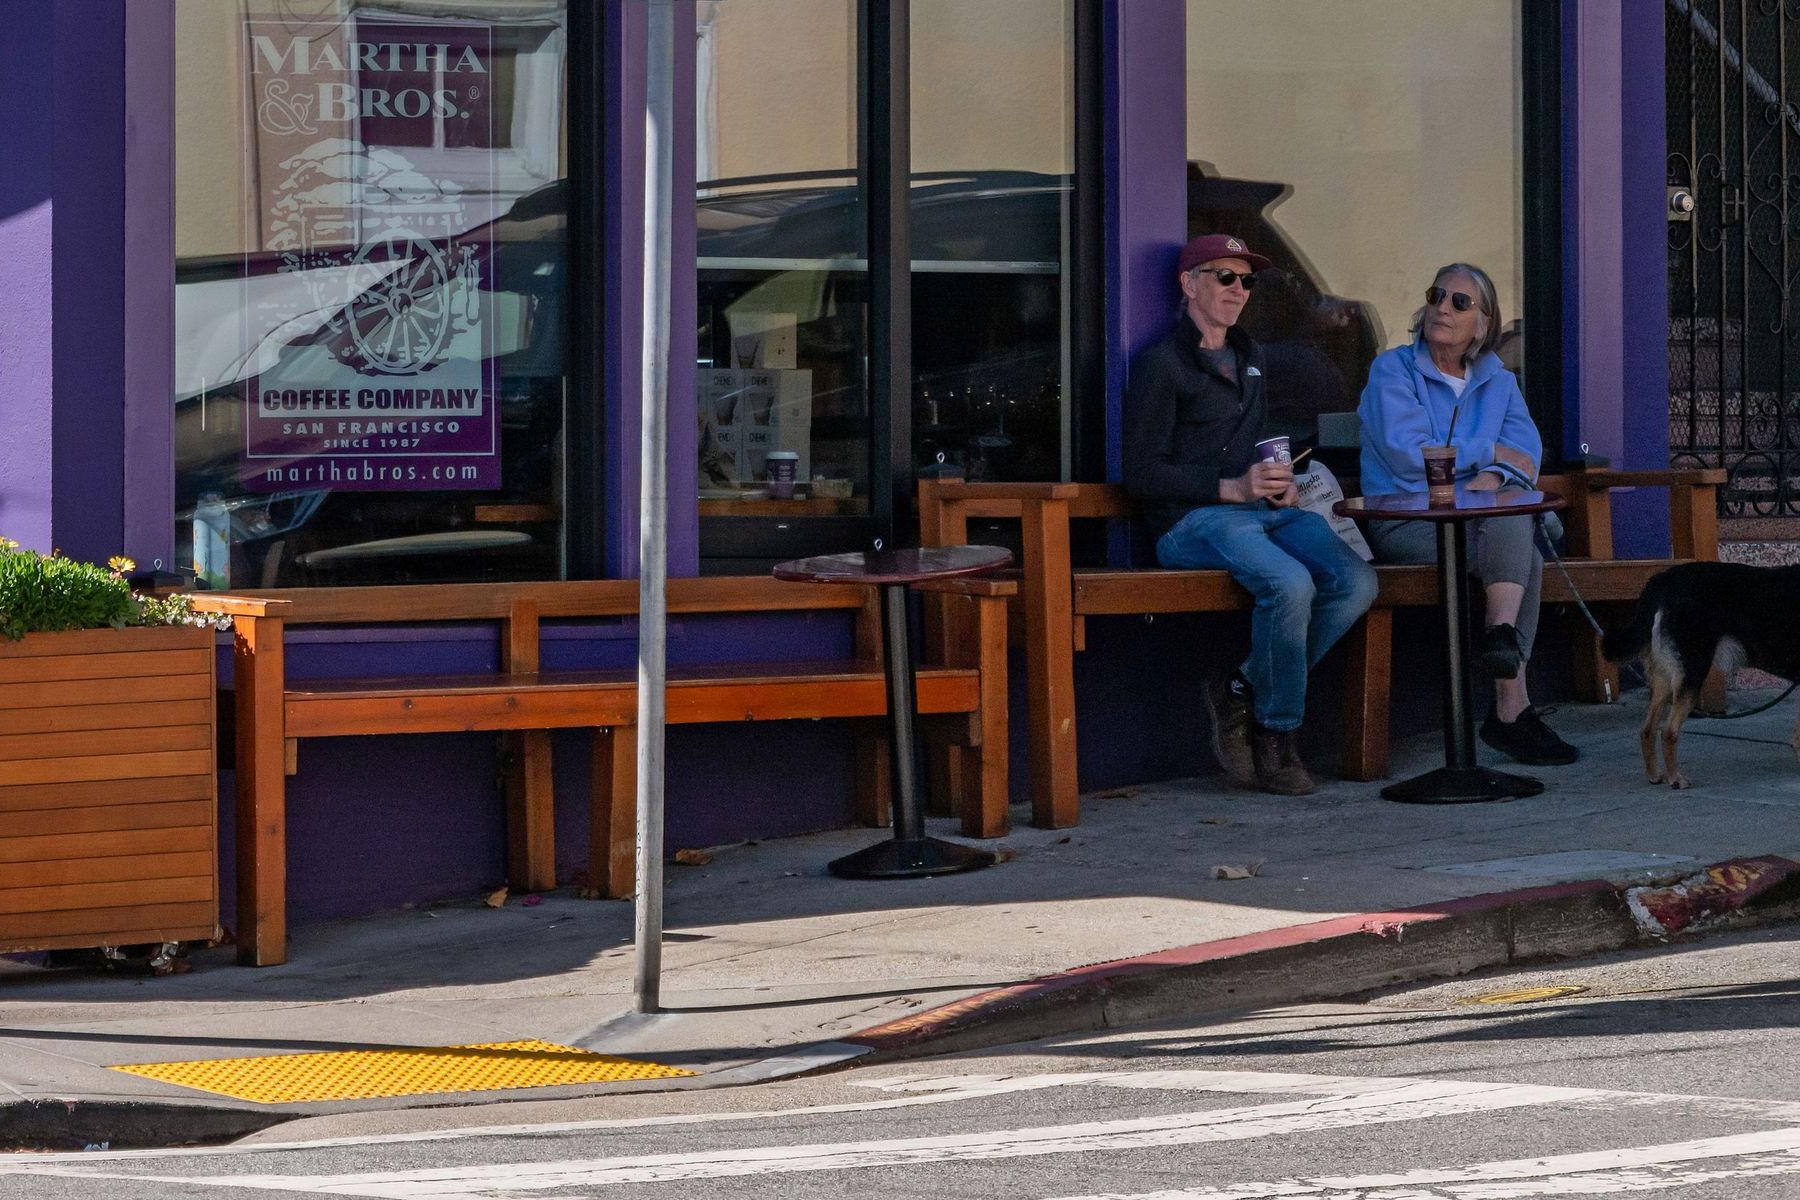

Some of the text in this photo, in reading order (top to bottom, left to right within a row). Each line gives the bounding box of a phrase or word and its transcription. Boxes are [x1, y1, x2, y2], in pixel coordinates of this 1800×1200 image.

[250, 35, 488, 77] MARTHA
[263, 387, 480, 412] COFFEE COMPANY
[282, 420, 461, 436] SAN FRANCISCO
[323, 438, 422, 449] SINCE 1987
[266, 460, 479, 483] marthabros.com
